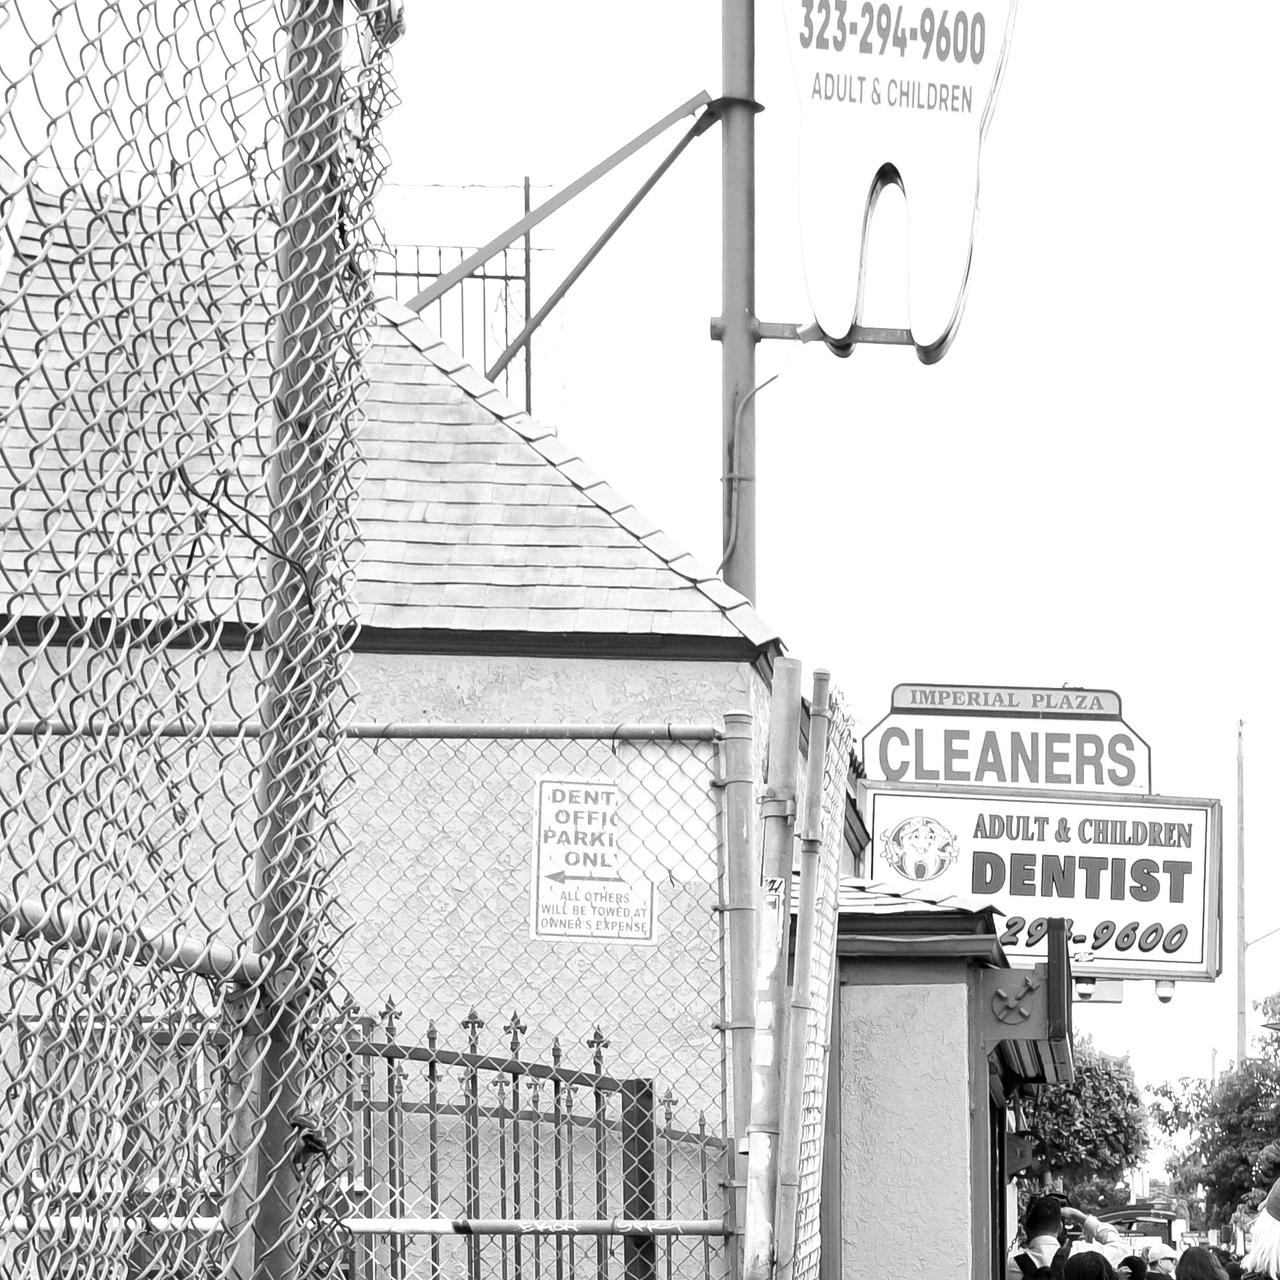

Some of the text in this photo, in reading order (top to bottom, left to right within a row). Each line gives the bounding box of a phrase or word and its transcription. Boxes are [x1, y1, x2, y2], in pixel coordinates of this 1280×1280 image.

[799, 0, 986, 64] 323-294-9600
[811, 72, 973, 113] ADULT & CHILDREN
[910, 689, 1105, 711] IMPERIAL PLAZA
[879, 726, 1137, 787] CLEANERS
[552, 789, 618, 806] DENT
[555, 809, 618, 827] OFFIC
[543, 829, 614, 848] PARKI
[973, 813, 1193, 848] ADULT & CHILDREN
[971, 851, 1193, 904] DENTIST
[560, 890, 630, 904] ALL OTHERS
[541, 904, 647, 918] WILL BE TOWED AT
[541, 918, 647, 932] OWNER'S EXPENSE
[1000, 916, 1188, 954] 29-9600
